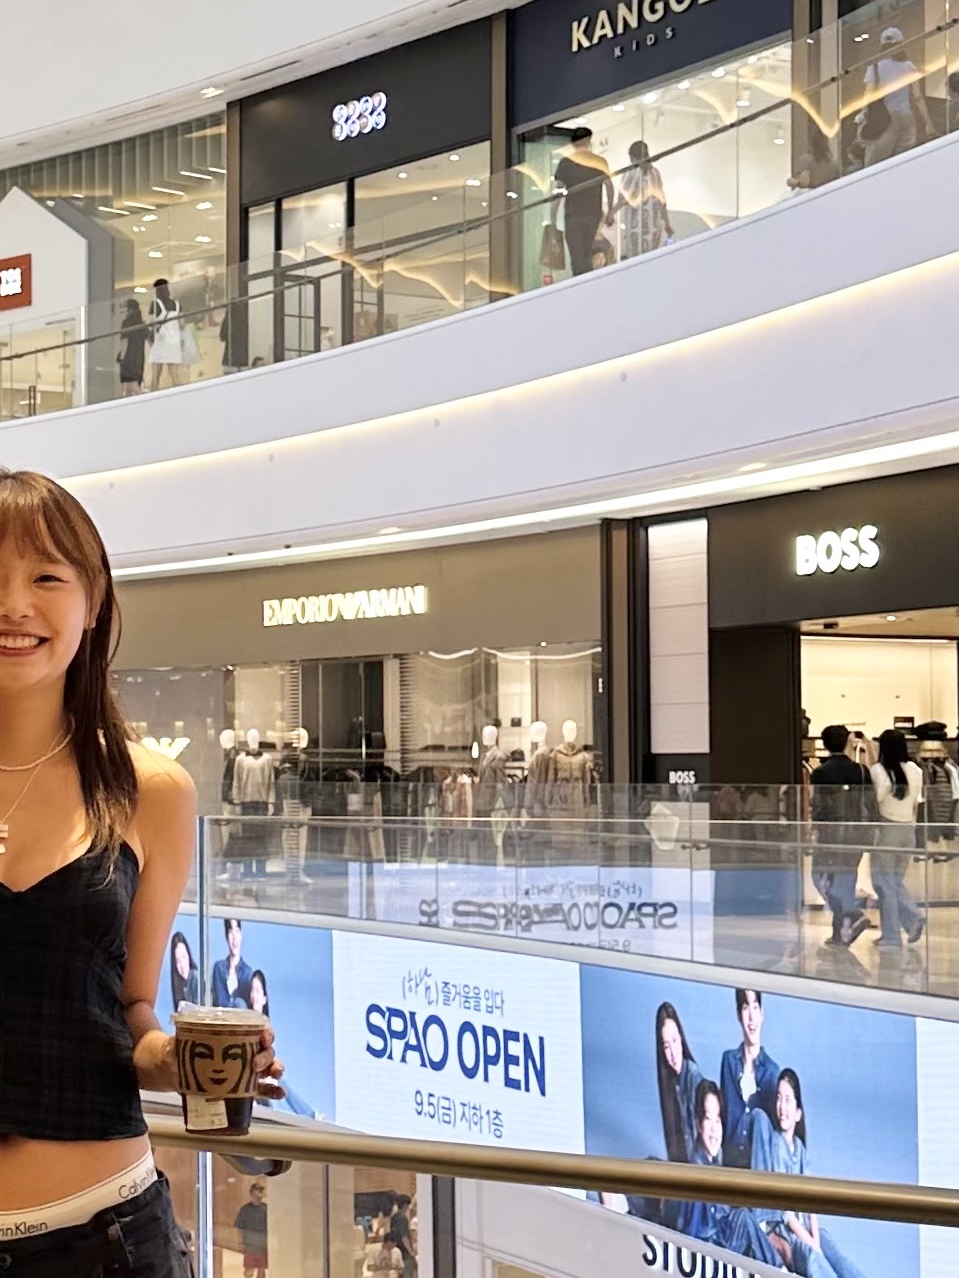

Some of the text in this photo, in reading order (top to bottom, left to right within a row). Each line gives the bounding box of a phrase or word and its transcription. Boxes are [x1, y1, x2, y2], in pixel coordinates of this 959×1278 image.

[571, 0, 716, 53] KANGO
[613, 26, 674, 58] KIDS
[796, 525, 880, 575] BOSS
[263, 585, 428, 627] EMPORIO ARMANI
[668, 770, 696, 784] BOSS
[441, 981, 481, 1012] 즐거움을
[483, 988, 504, 1017] 입다
[365, 1003, 546, 1098] SPAO OPEN
[414, 1089, 504, 1139] 9.5(금) 지하 1층
